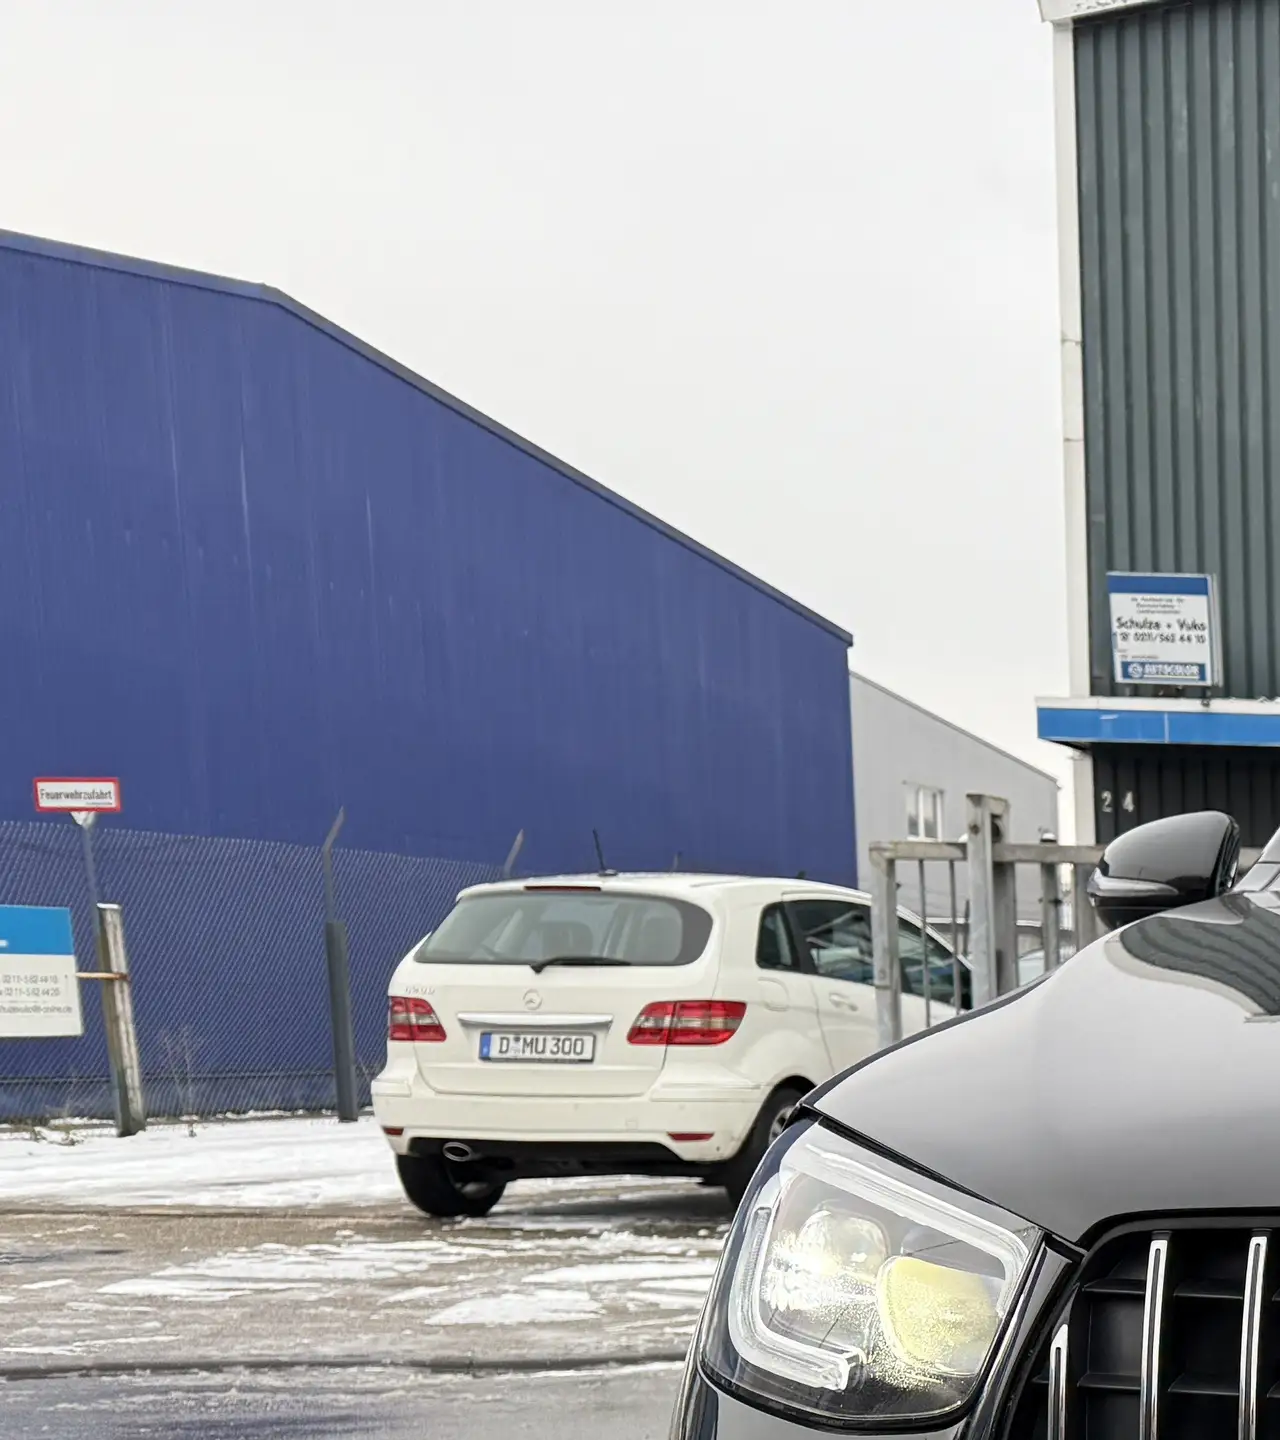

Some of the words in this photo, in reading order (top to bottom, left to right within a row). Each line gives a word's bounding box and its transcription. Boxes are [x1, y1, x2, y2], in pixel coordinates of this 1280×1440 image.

[40, 788, 112, 799] Feuerwehrzufahrt
[499, 1036, 511, 1055] D
[521, 1037, 546, 1056] MU
[550, 1038, 585, 1056] 300
